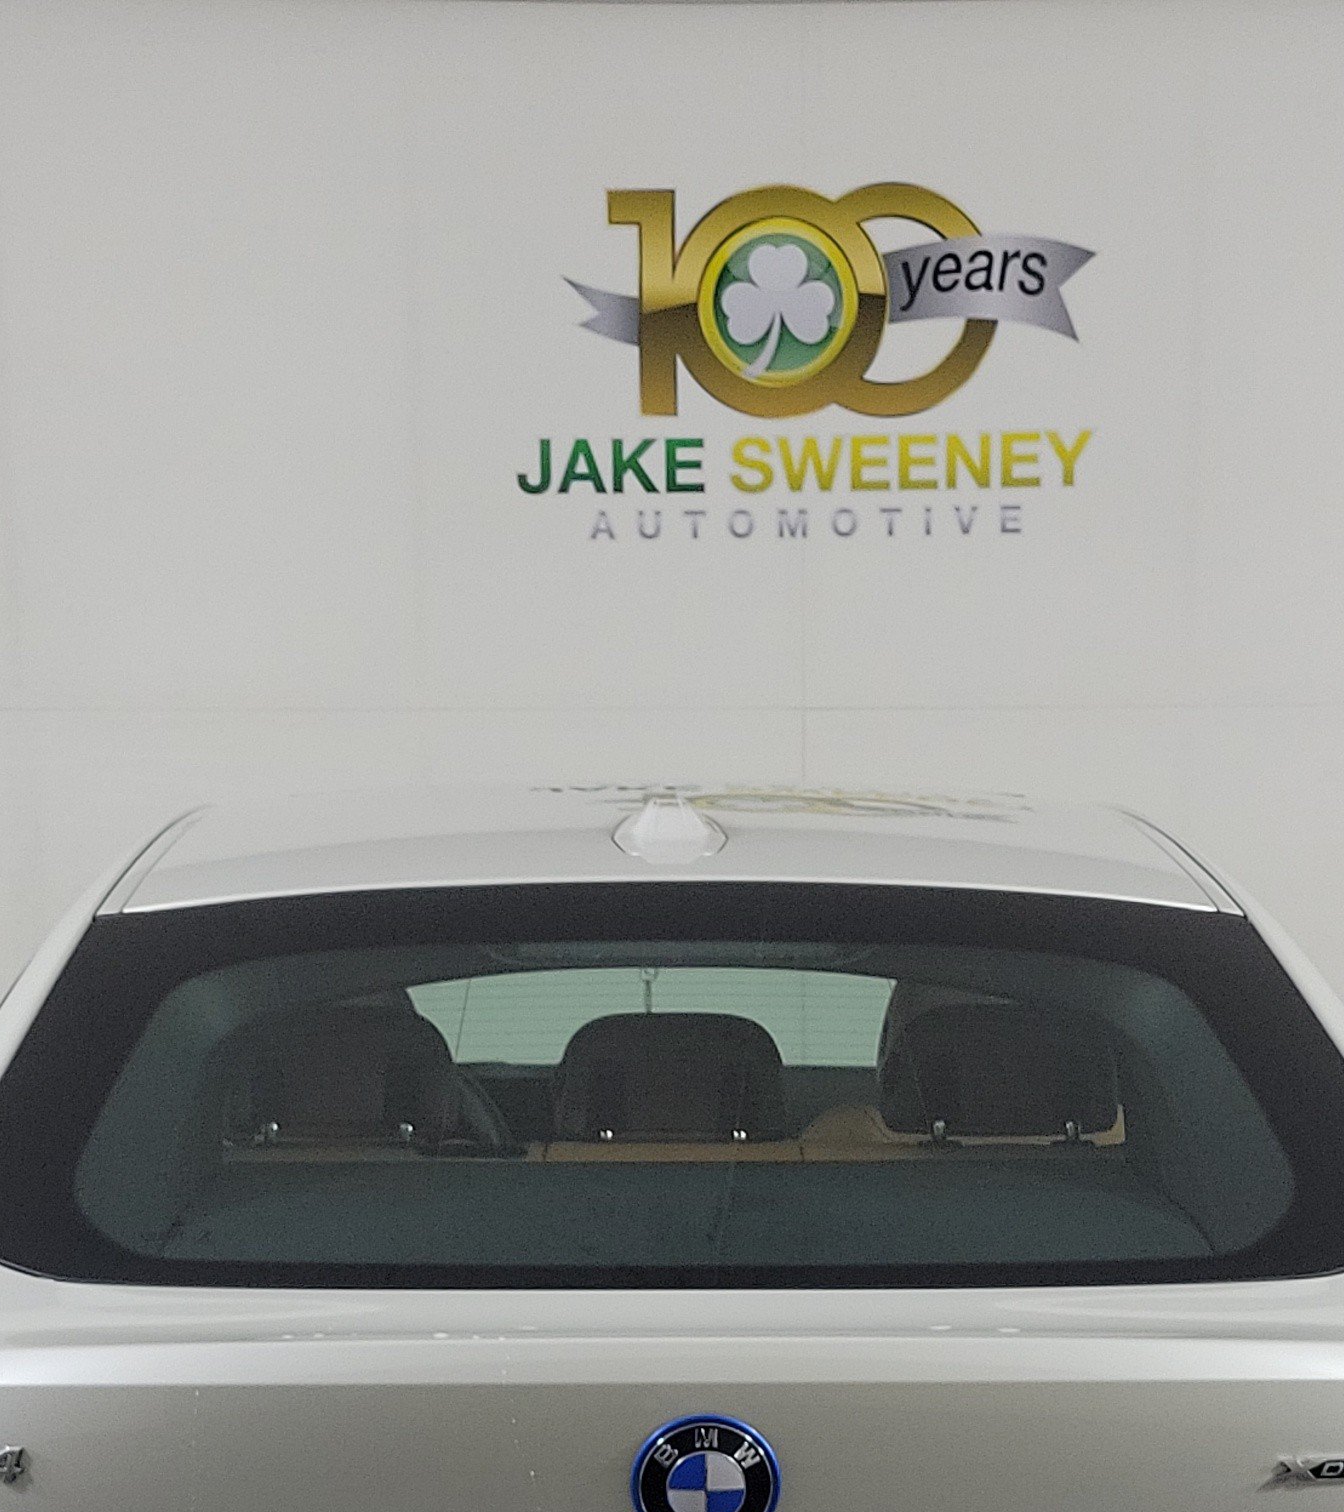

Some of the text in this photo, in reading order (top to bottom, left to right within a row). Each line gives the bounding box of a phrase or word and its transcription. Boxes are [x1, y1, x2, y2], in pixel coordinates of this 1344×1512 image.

[606, 182, 998, 419] 100
[899, 248, 1049, 311] years
[517, 429, 1092, 495] JAKE SWEENEY
[590, 506, 1022, 541] AUTOMOTIVE
[654, 1427, 761, 1469] BMW
